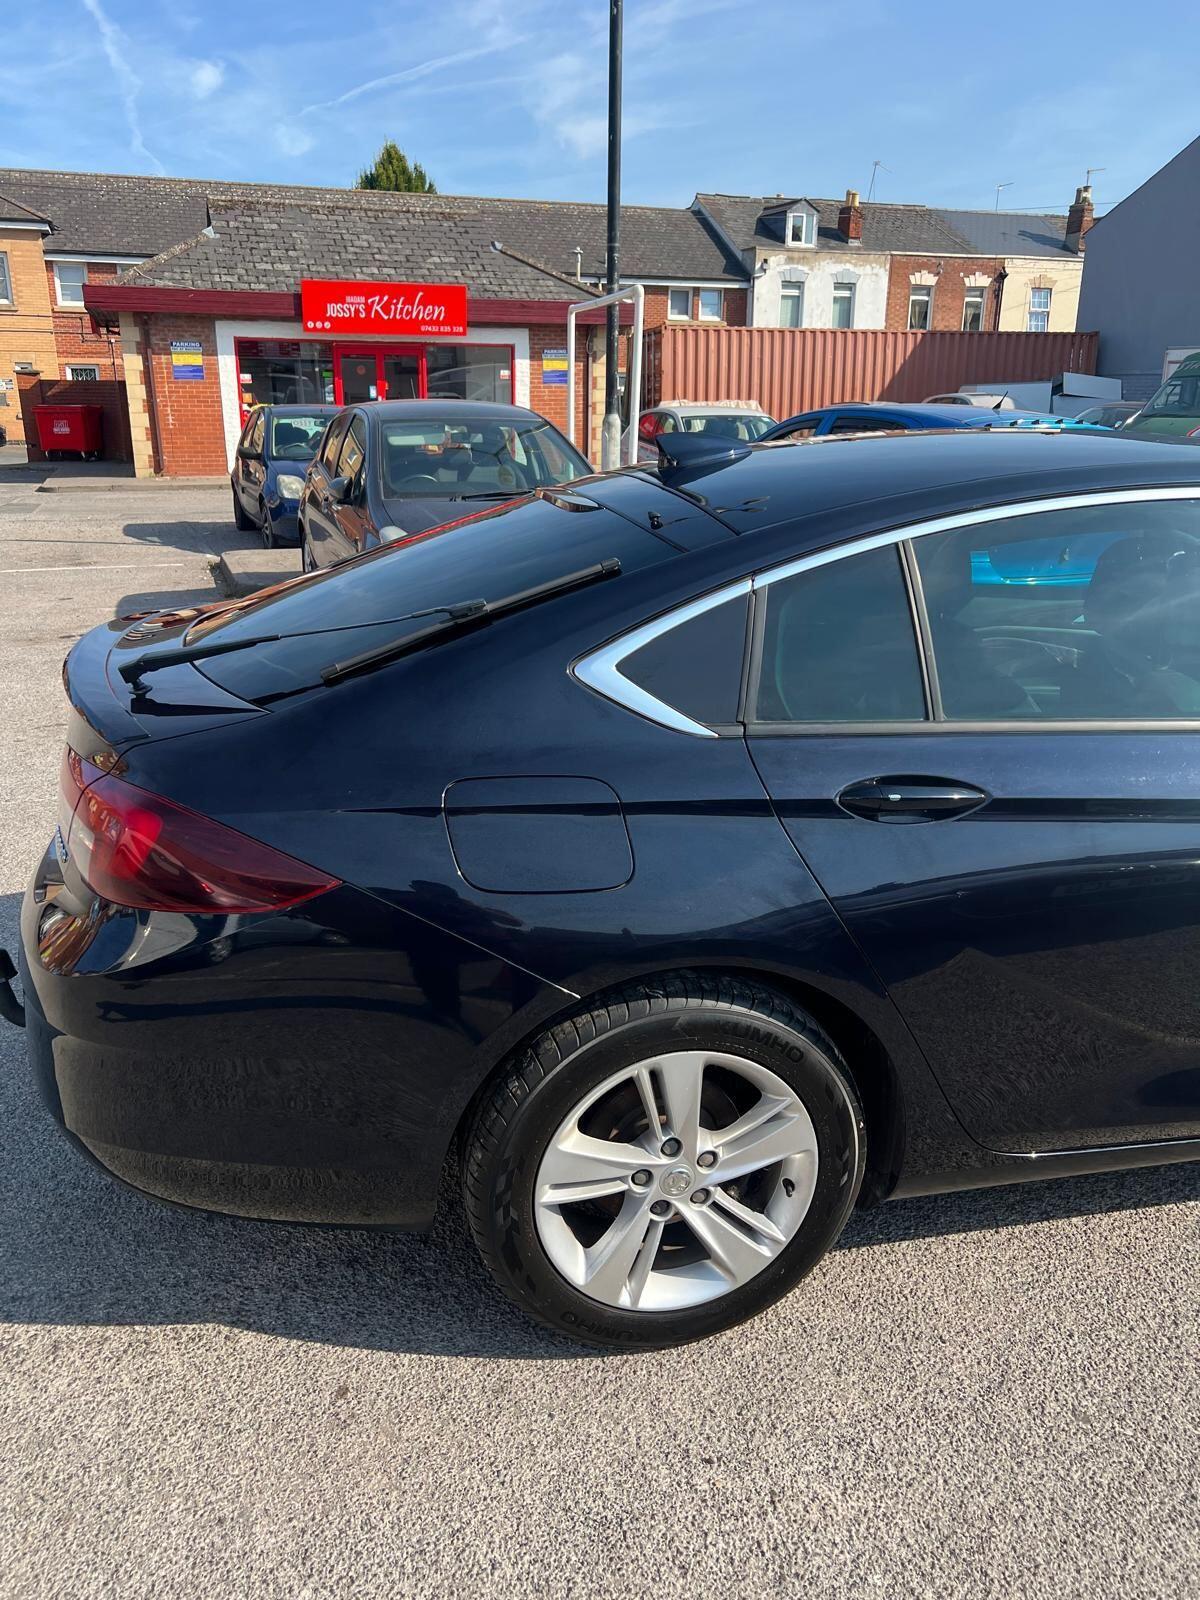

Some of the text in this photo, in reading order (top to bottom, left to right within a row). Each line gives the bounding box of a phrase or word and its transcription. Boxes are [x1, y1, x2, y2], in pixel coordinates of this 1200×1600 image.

[326, 291, 446, 321] JOSSY'S Kitchen
[717, 1020, 804, 1064] KUMHO
